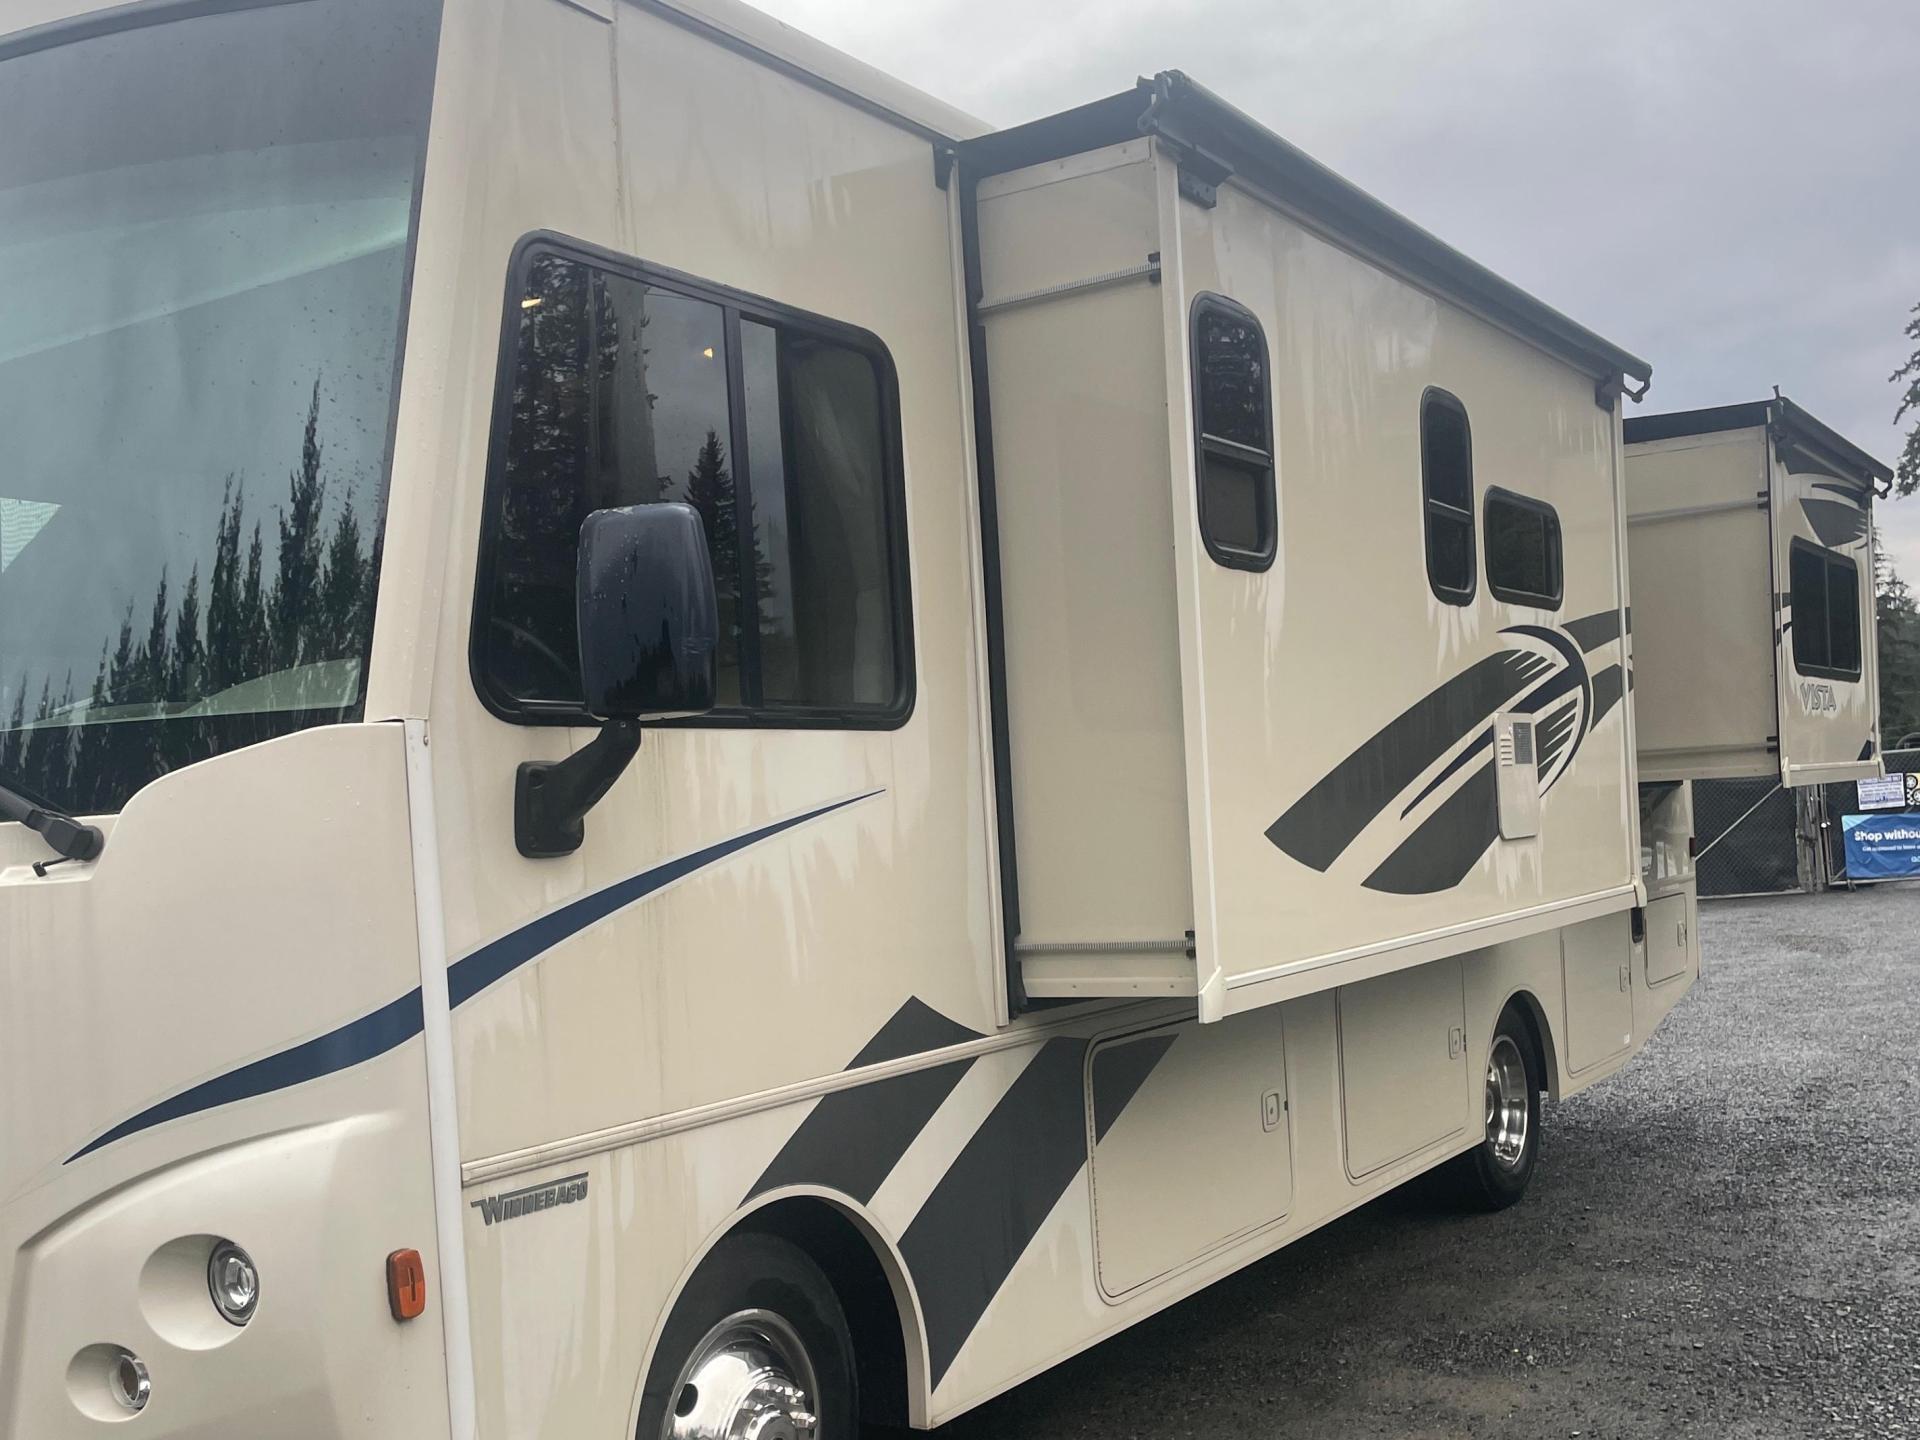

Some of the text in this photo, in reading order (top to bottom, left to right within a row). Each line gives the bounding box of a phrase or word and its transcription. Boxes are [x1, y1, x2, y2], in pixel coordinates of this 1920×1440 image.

[1800, 683, 1837, 711] VISTA
[1854, 831, 1883, 842] Shop
[471, 1172, 588, 1226] WINNEBAGO
